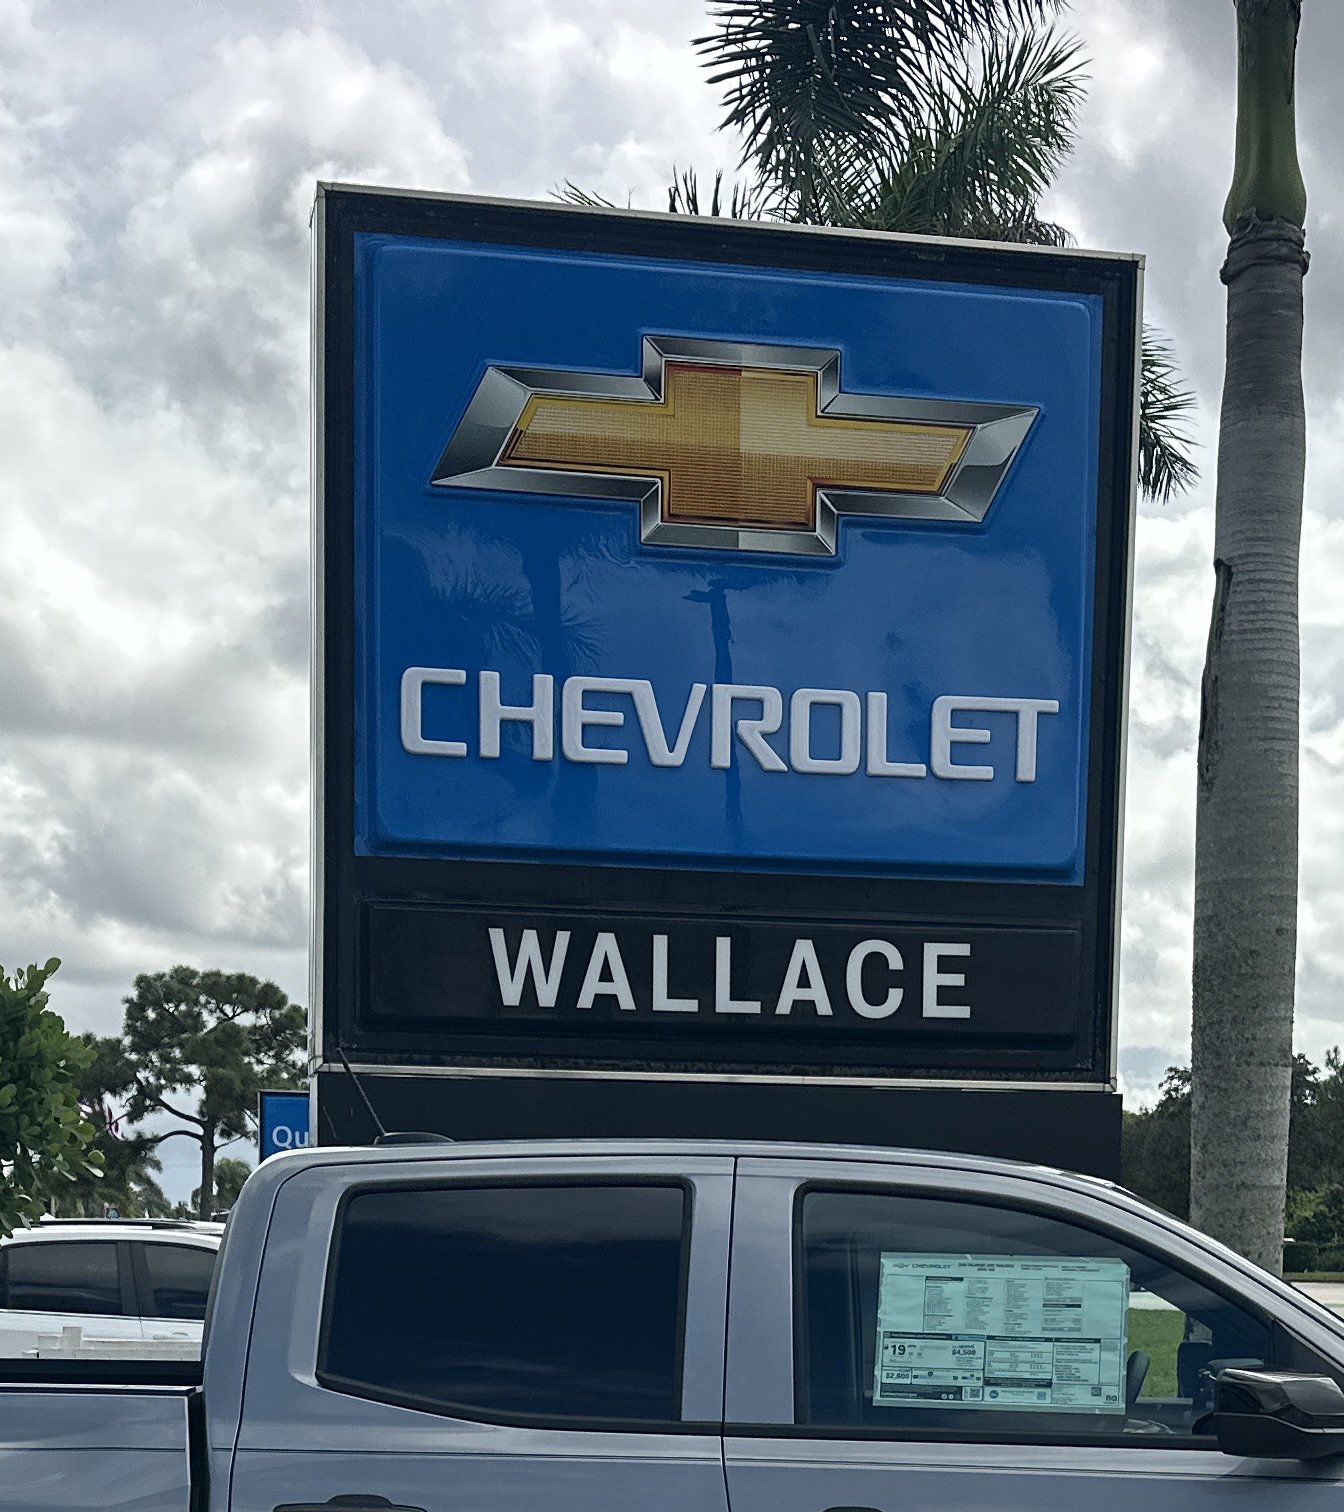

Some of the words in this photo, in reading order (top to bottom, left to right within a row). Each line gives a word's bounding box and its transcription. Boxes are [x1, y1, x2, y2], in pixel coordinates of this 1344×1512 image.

[400, 666, 1060, 783] CHEVROLET
[488, 927, 971, 1020] WALLACE
[272, 1125, 309, 1150] Qu
[891, 1344, 906, 1356] 19
